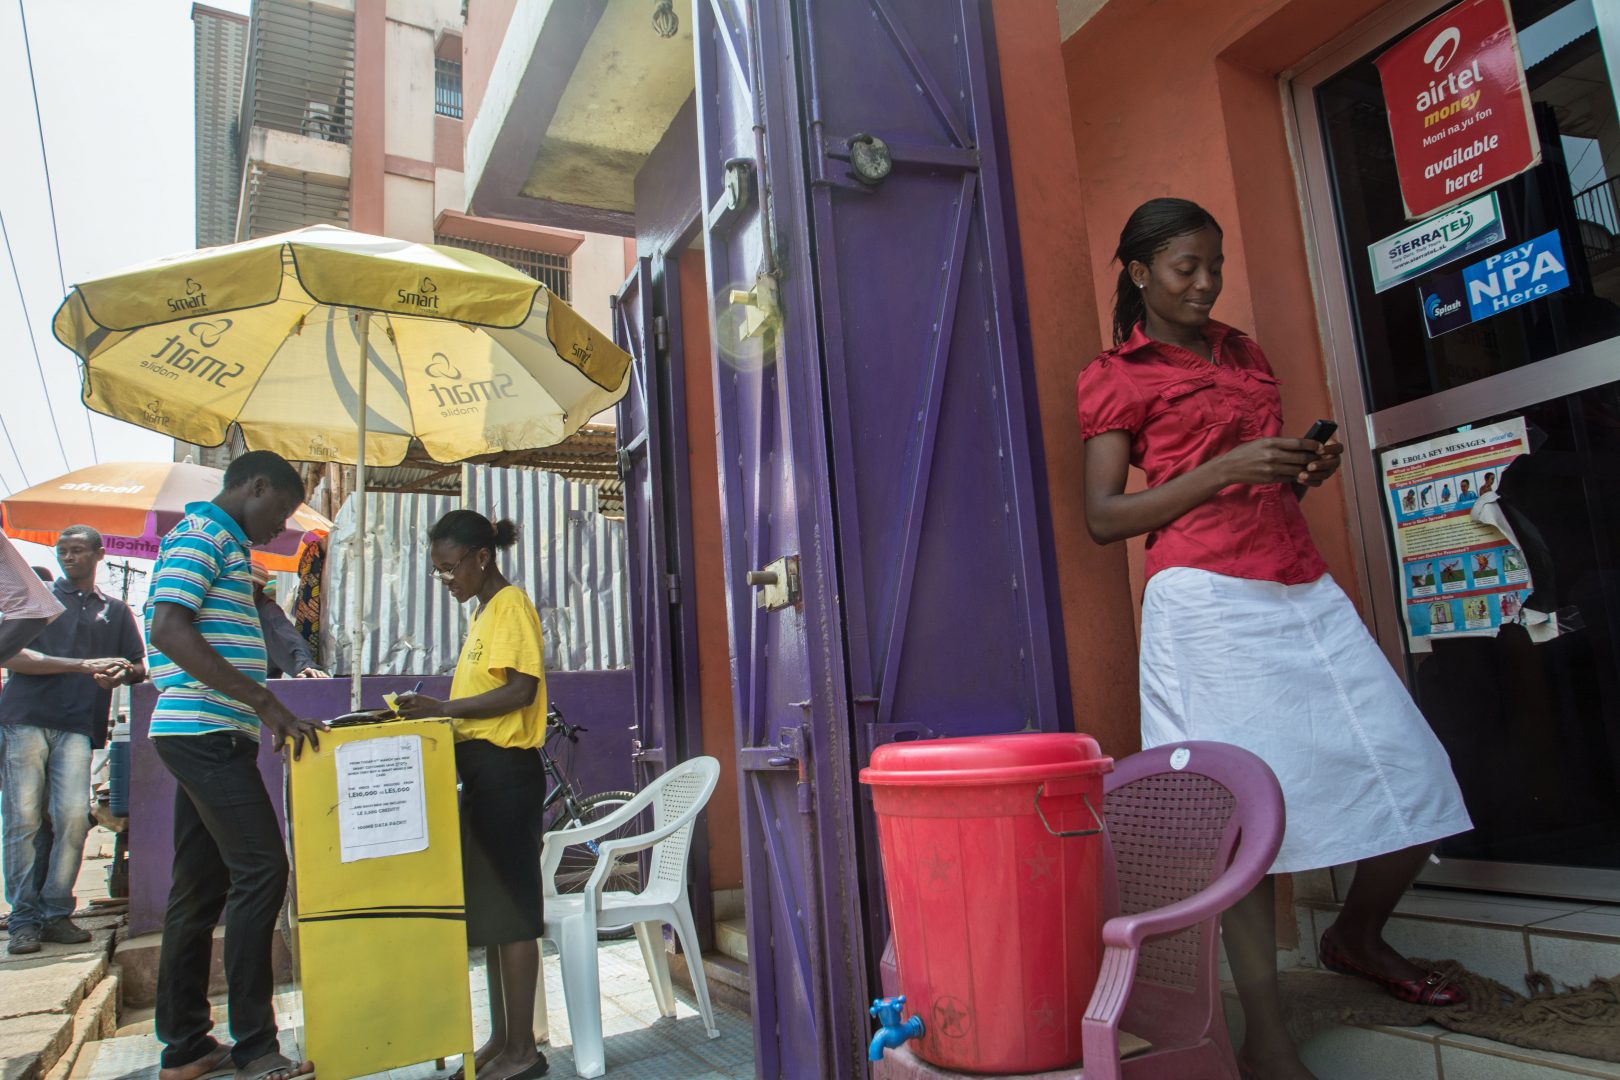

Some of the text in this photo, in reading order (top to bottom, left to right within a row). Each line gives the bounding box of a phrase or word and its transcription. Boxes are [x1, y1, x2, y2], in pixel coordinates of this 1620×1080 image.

[1416, 59, 1484, 111] airtel
[1424, 89, 1481, 128] money
[1422, 108, 1492, 147] Moni na yu fon
[1424, 134, 1499, 179] available
[1445, 163, 1483, 195] here!
[1388, 216, 1470, 259] SIERRATEL
[1485, 243, 1534, 270] Pay
[1468, 250, 1565, 306] NPA
[167, 292, 207, 313] Smart
[397, 288, 440, 309] Smart
[1434, 299, 1462, 317] Splash
[1493, 283, 1549, 311] Here
[1402, 454, 1427, 465] EBOLA
[1428, 449, 1443, 458] KEY
[1445, 439, 1487, 453] MESSAGES
[59, 482, 145, 495] africell
